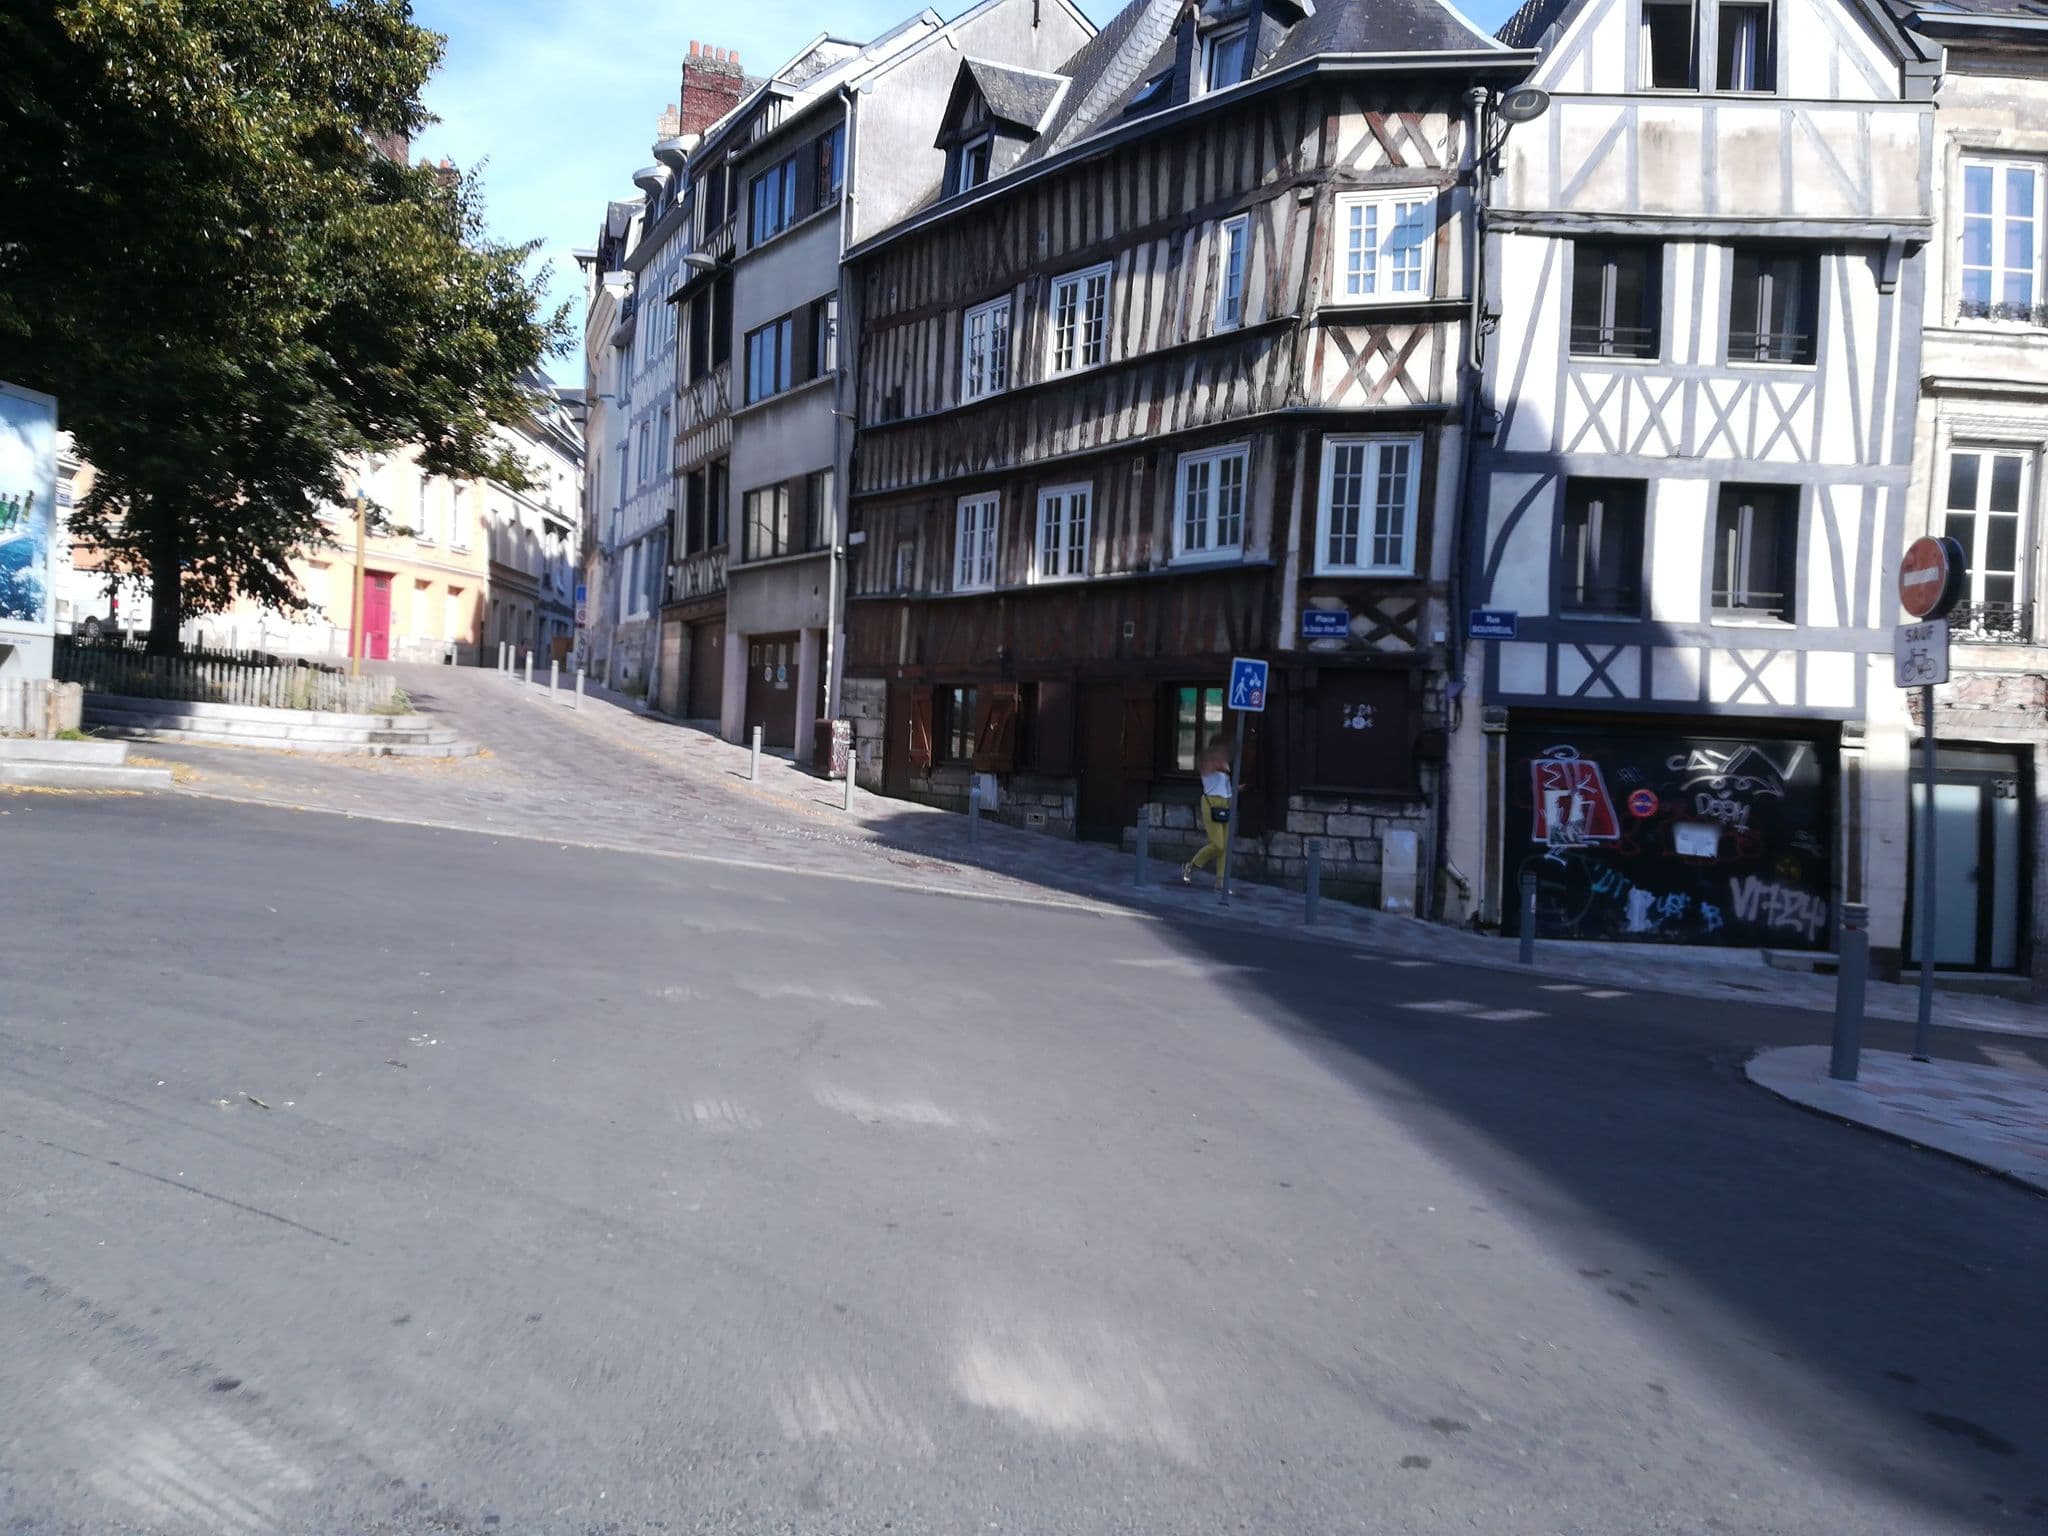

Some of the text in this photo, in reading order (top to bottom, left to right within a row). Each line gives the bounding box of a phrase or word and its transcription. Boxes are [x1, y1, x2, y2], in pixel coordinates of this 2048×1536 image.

[1315, 615, 1336, 623] Place
[1486, 615, 1501, 624] Rue
[1905, 625, 1934, 643] SAUF
